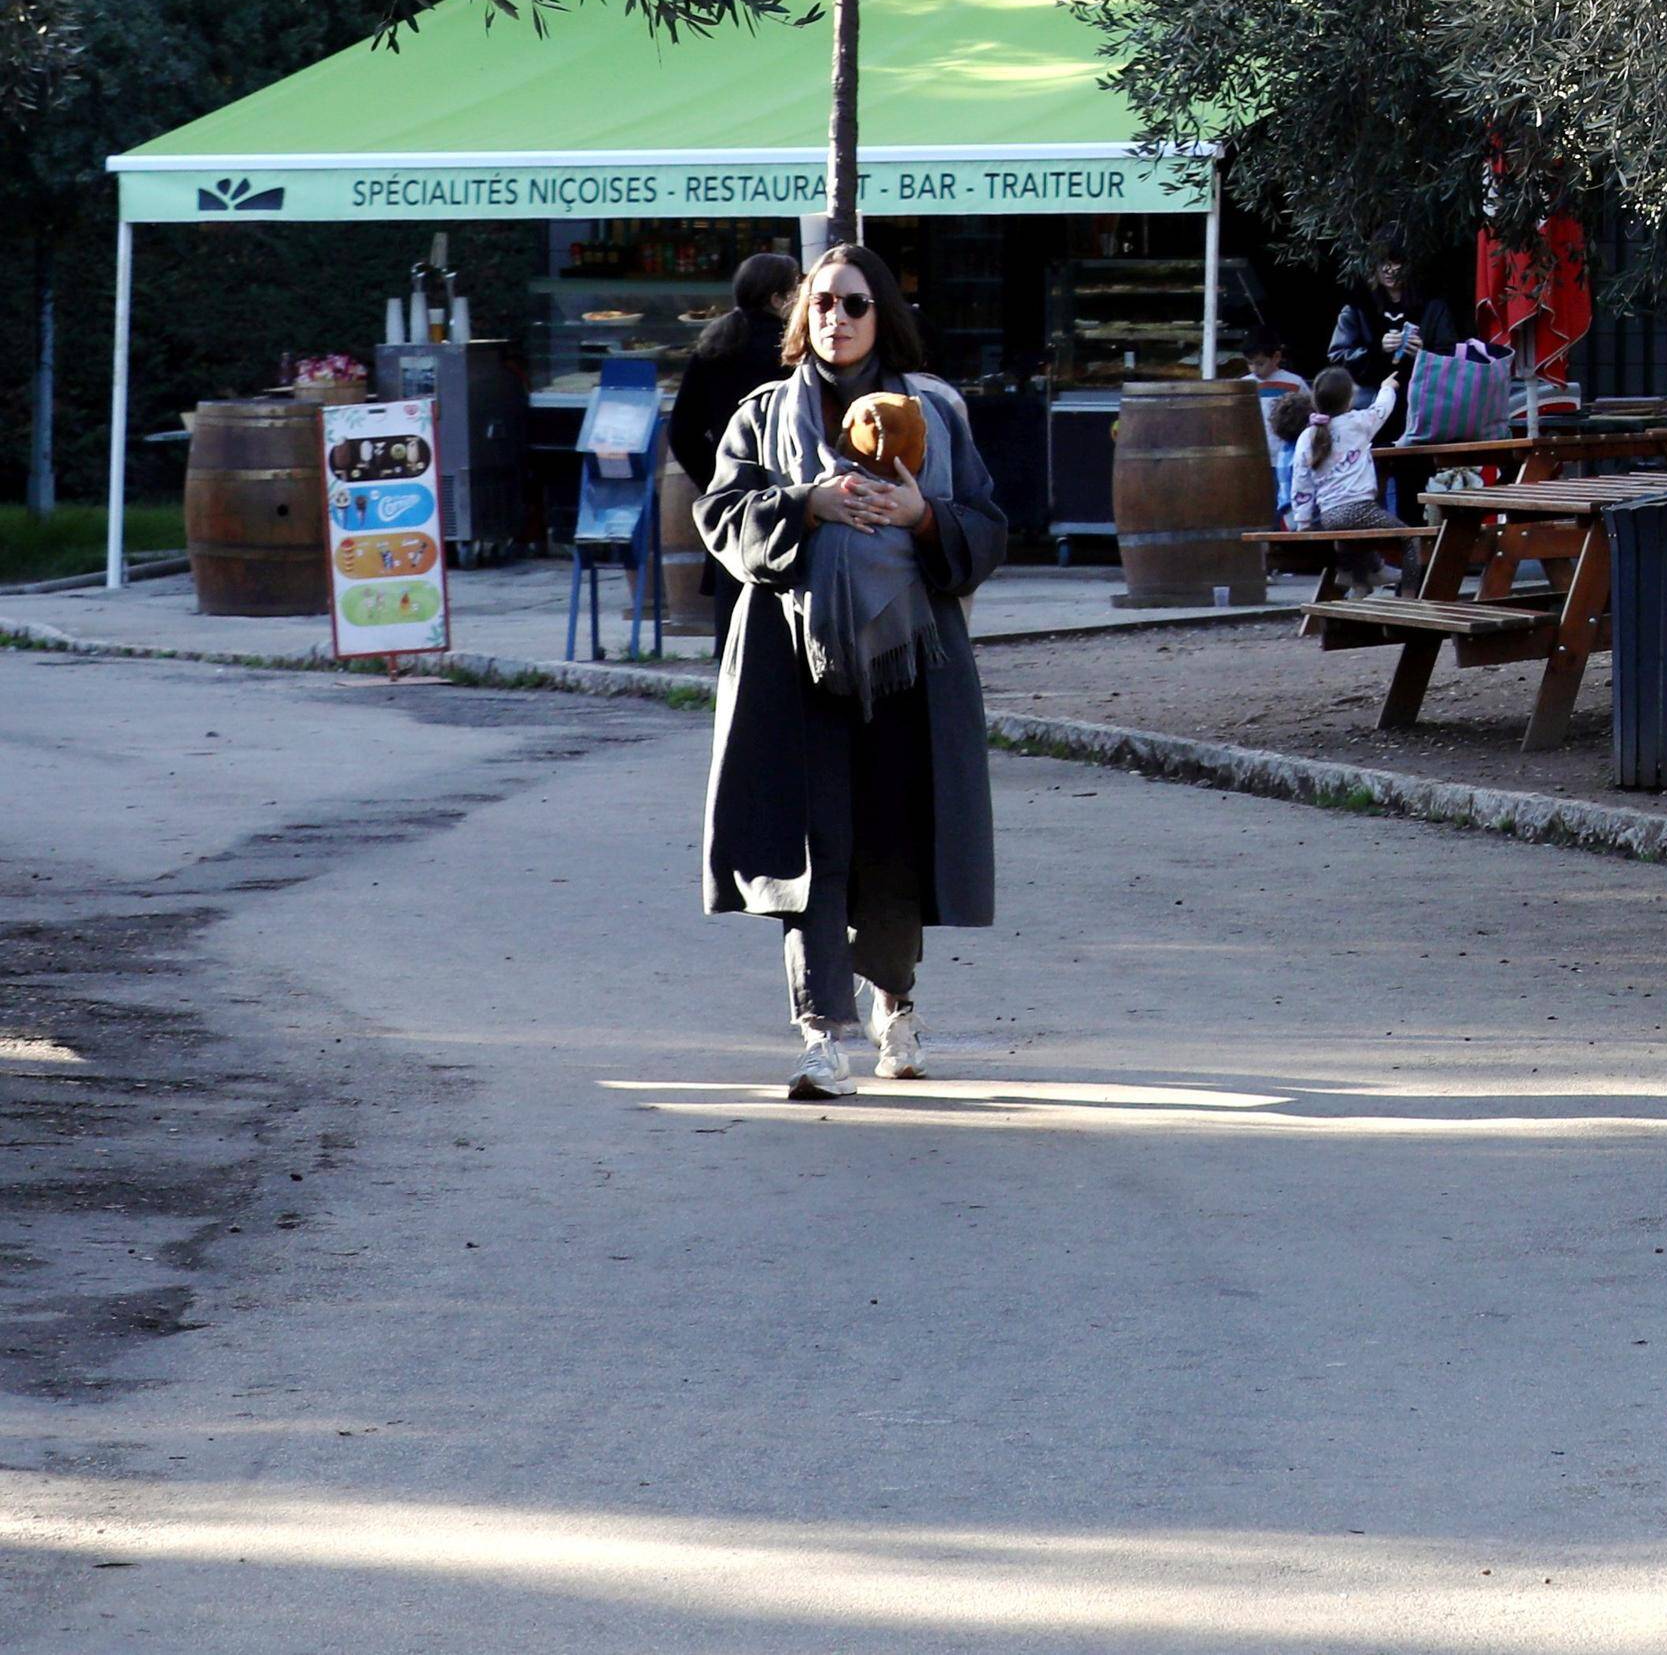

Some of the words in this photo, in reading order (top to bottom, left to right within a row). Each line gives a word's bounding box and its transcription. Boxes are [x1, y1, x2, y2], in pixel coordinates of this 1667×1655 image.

[353, 173, 518, 207] SPÉCIALITÉS
[529, 176, 657, 213] NIÇOISES
[686, 174, 871, 202] RESTAURAT
[900, 173, 956, 200] BAR
[984, 171, 1126, 200] TRAITEUR
